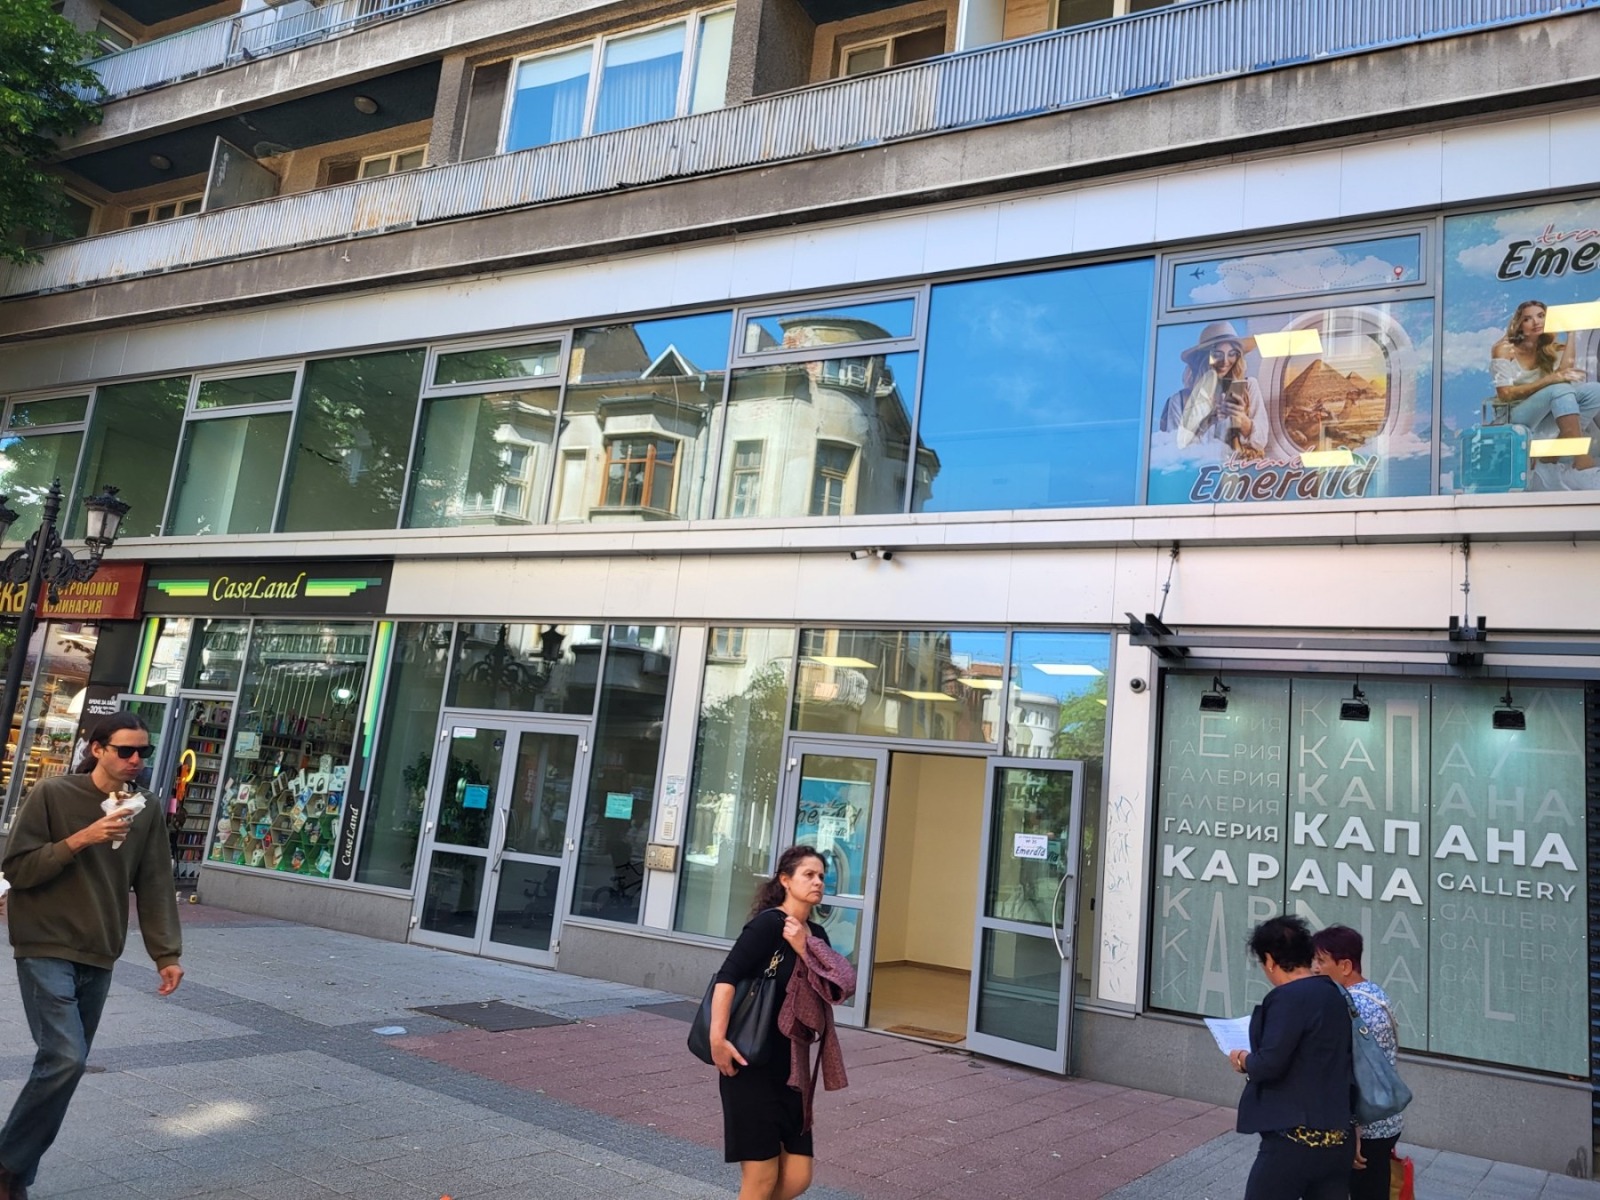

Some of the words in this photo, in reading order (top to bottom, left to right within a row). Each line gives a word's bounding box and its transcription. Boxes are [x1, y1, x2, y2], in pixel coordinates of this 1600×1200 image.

[1496, 239, 1600, 281] Eme
[1190, 455, 1378, 503] Emerald
[212, 572, 306, 601] CaseLand
[342, 804, 359, 866] CaseLand
[1015, 846, 1046, 857] Emerald
[1164, 816, 1279, 843] ГАЛЕРИЯ
[1293, 811, 1579, 872] КАПАНА
[1162, 844, 1424, 906] KAPANA
[1436, 872, 1577, 902] GALLERY
